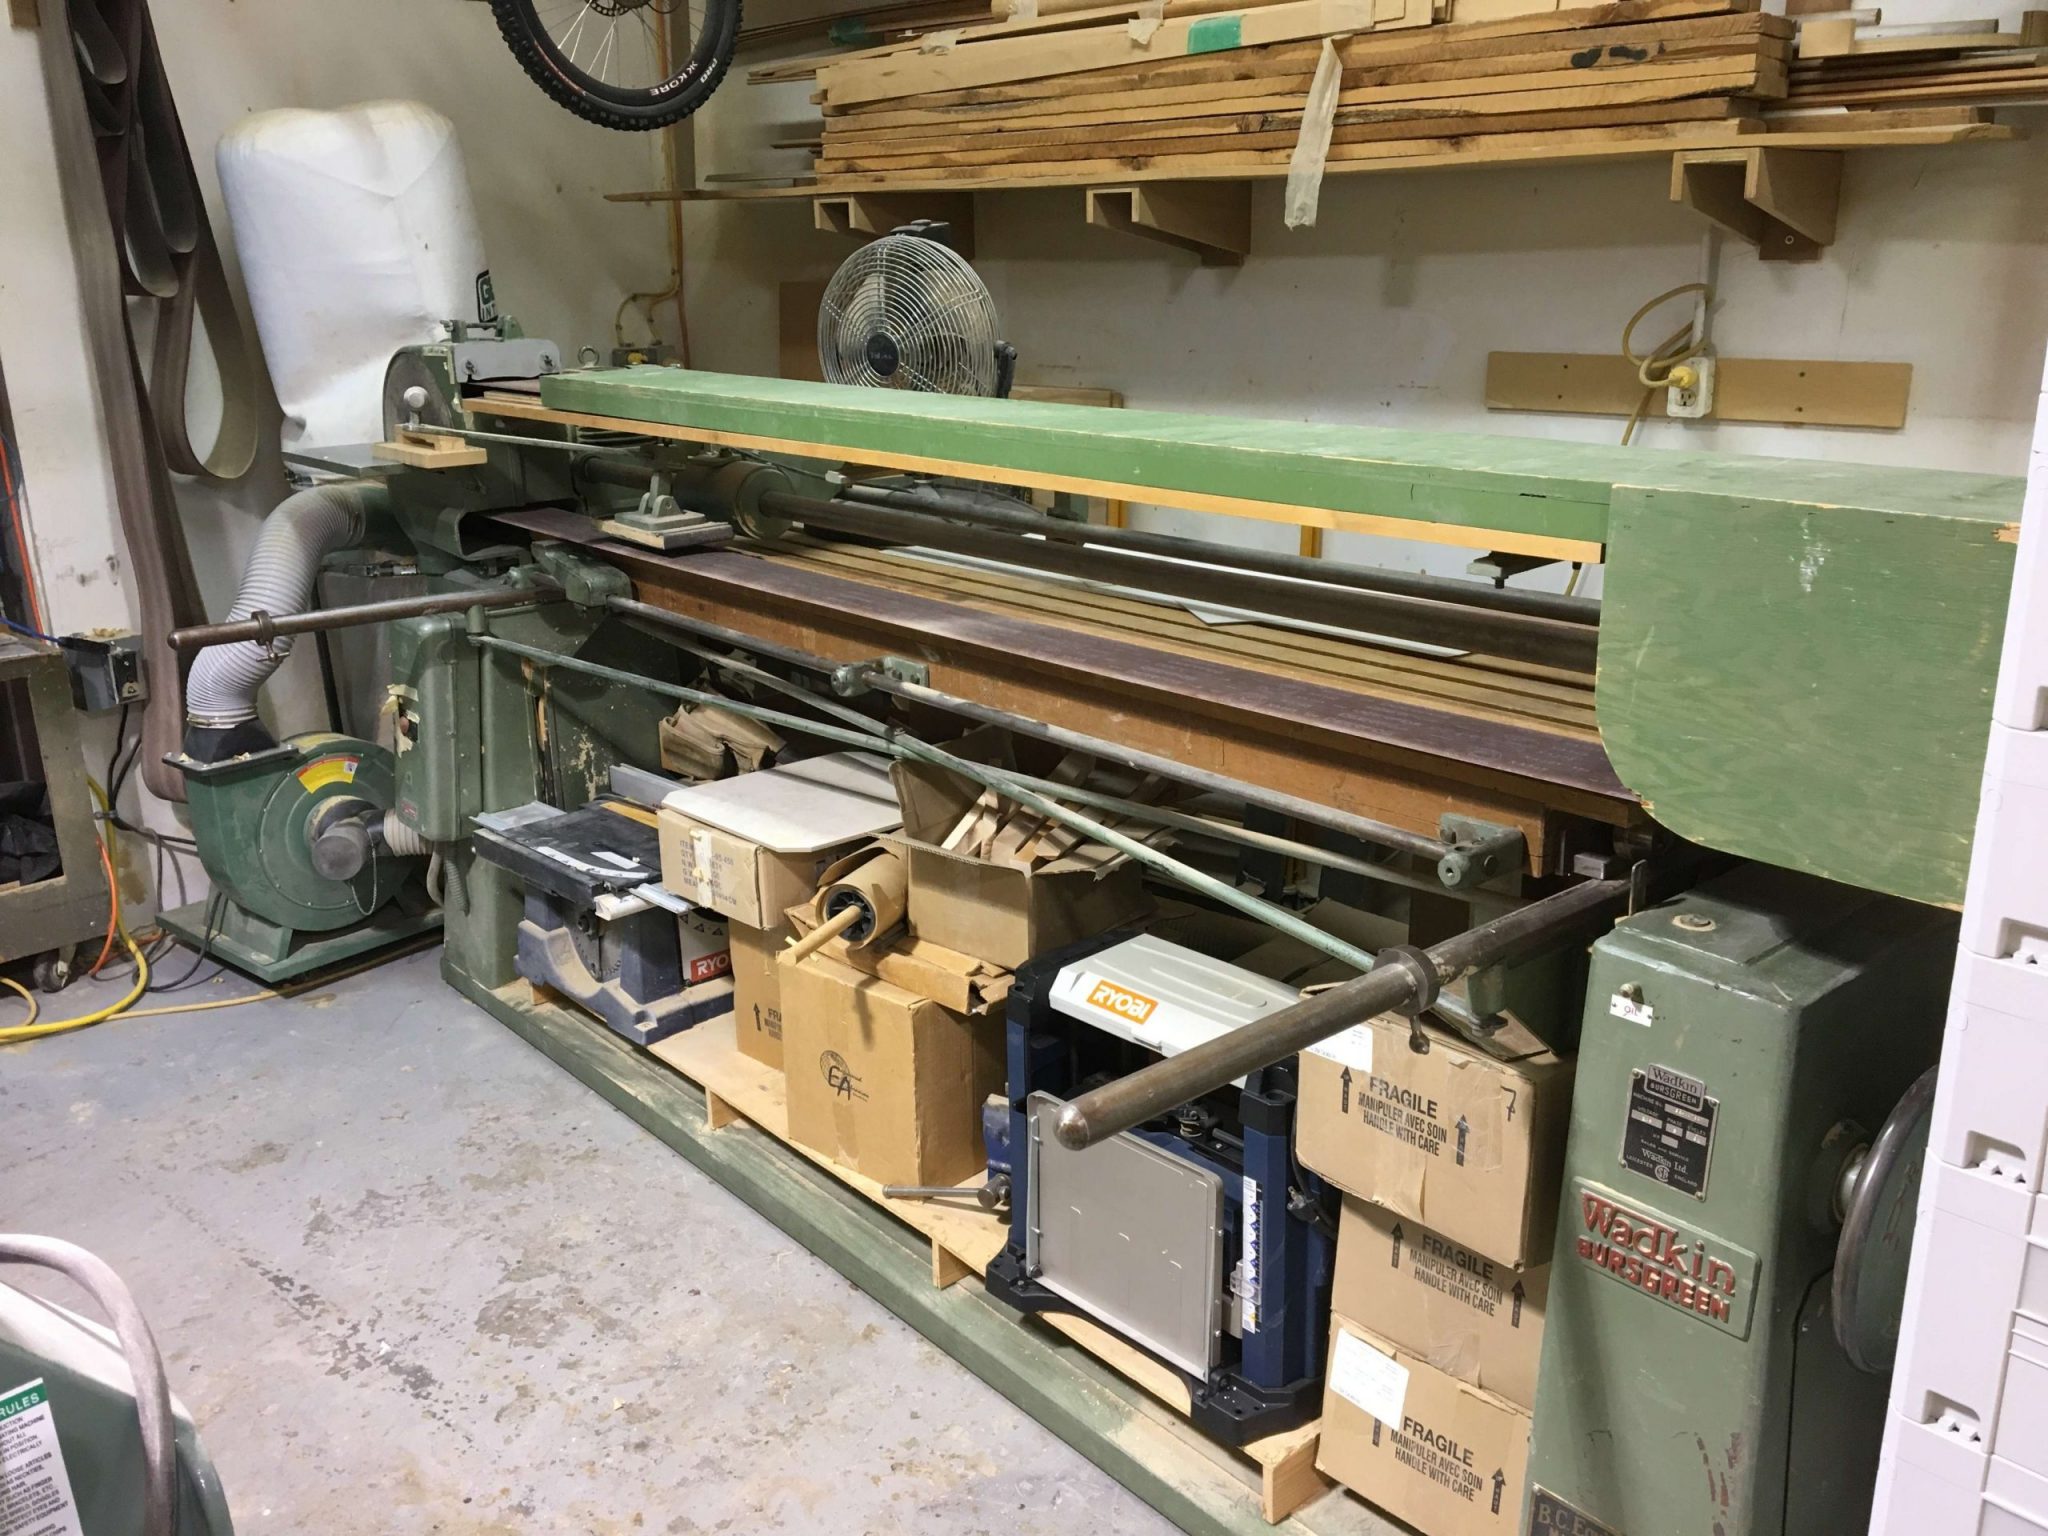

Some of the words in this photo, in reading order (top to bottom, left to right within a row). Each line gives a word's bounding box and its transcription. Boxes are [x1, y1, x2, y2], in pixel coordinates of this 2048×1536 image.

[700, 58, 718, 83] PRO
[696, 953, 729, 976] RYO
[1093, 984, 1152, 1019] RYOBI
[1370, 1076, 1438, 1119] FRAGILE
[1649, 1083, 1697, 1104] BURSGREEN
[1652, 1067, 1697, 1094] Wadkin
[1358, 1091, 1402, 1124] MANIPULER
[1404, 1113, 1425, 1134] AVEC
[1427, 1123, 1447, 1143] SOIN
[1363, 1109, 1394, 1137] HANDLE
[1395, 1126, 1416, 1146] WITH
[1418, 1134, 1440, 1157] CARE
[1641, 1148, 1672, 1168] Wadkin
[1422, 1234, 1494, 1280] FRAGILE
[1581, 1187, 1736, 1297] Wadkin
[1410, 1249, 1457, 1282] MANIPULER
[1458, 1273, 1479, 1293] AVEC
[1482, 1284, 1503, 1305] SOIN
[1414, 1266, 1447, 1293] HANDLE
[1449, 1284, 1470, 1305] WITH
[1472, 1294, 1495, 1317] CARE
[1577, 1235, 1730, 1324] BURSGREEN
[0, 1393, 40, 1417] RULES
[1390, 1429, 1437, 1466] MANIPULER
[1438, 1456, 1461, 1479] AVEC
[1462, 1469, 1483, 1491] SOIN
[1403, 1416, 1475, 1467] FRAGILE
[1394, 1447, 1427, 1475] HANDLE
[1428, 1466, 1450, 1489] WITH
[1452, 1479, 1475, 1503] CARE
